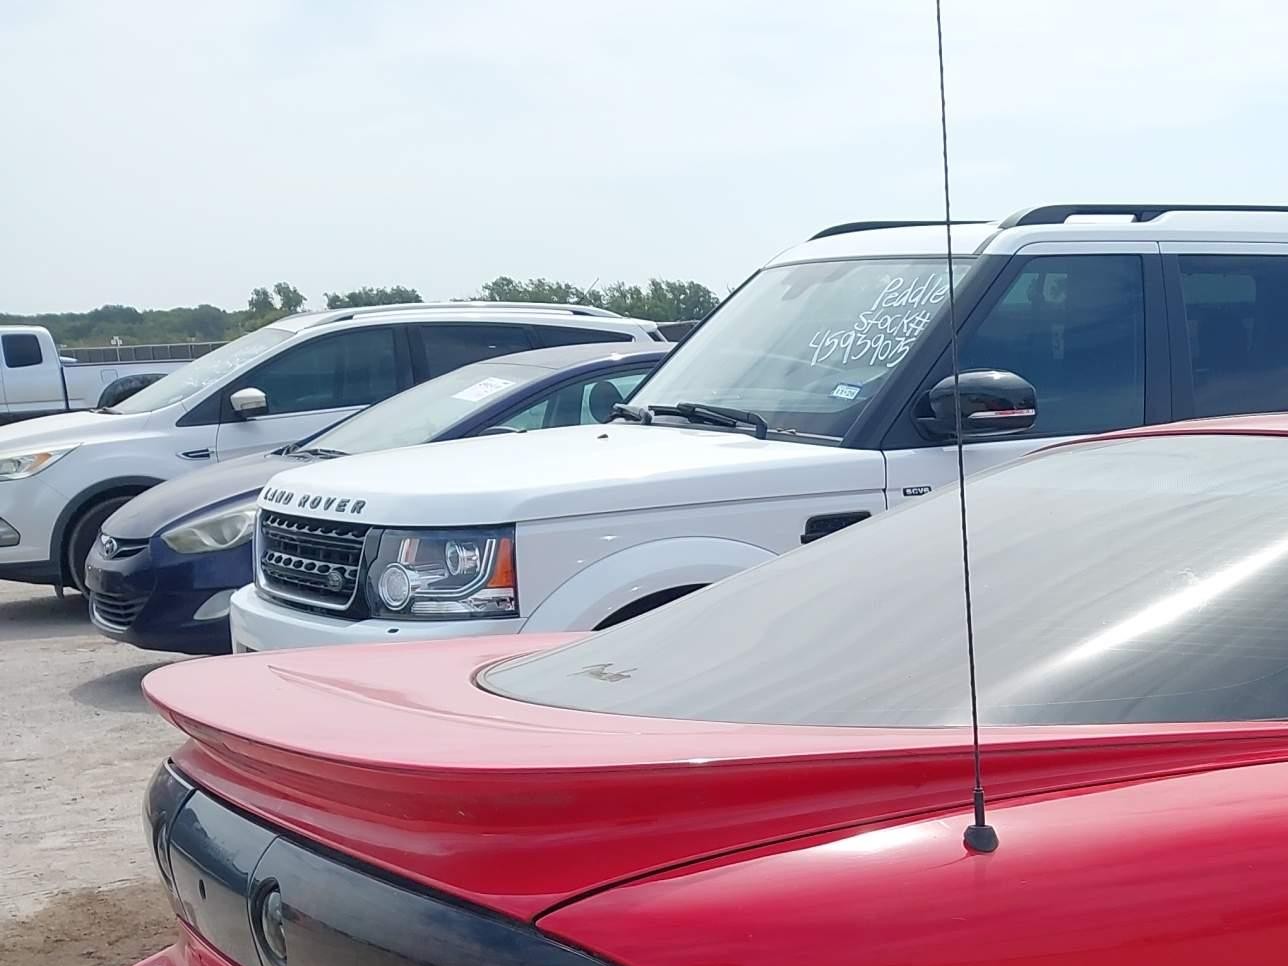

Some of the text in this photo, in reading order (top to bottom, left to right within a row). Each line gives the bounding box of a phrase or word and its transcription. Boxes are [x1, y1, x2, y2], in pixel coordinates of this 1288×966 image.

[871, 273, 949, 311] Peddle
[264, 488, 366, 514] LAND ROVER
